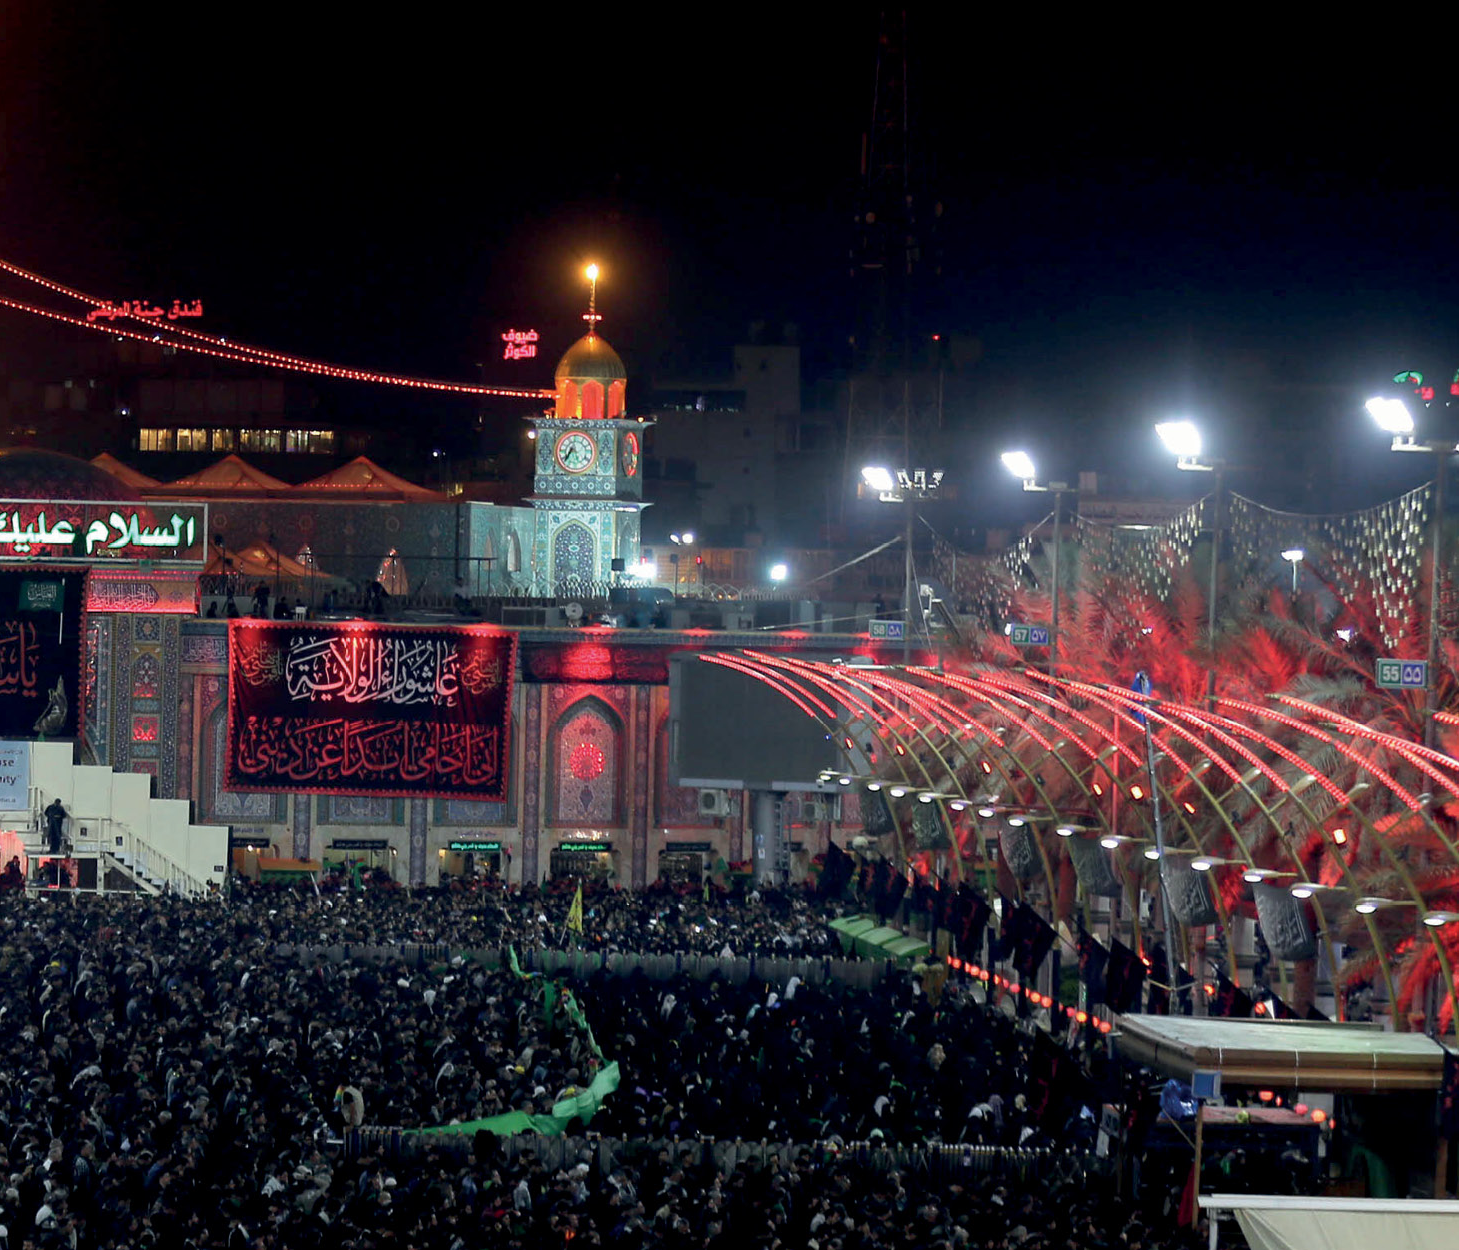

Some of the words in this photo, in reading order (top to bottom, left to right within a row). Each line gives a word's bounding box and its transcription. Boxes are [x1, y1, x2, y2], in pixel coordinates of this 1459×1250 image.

[167, 299, 202, 319] فندق
[502, 328, 539, 344] ضيوف
[503, 342, 536, 360] الكوثر
[86, 511, 195, 554] السلام
[1014, 629, 1028, 641] 57
[1383, 665, 1400, 682] 55
[1403, 666, 1422, 682] ٥٥
